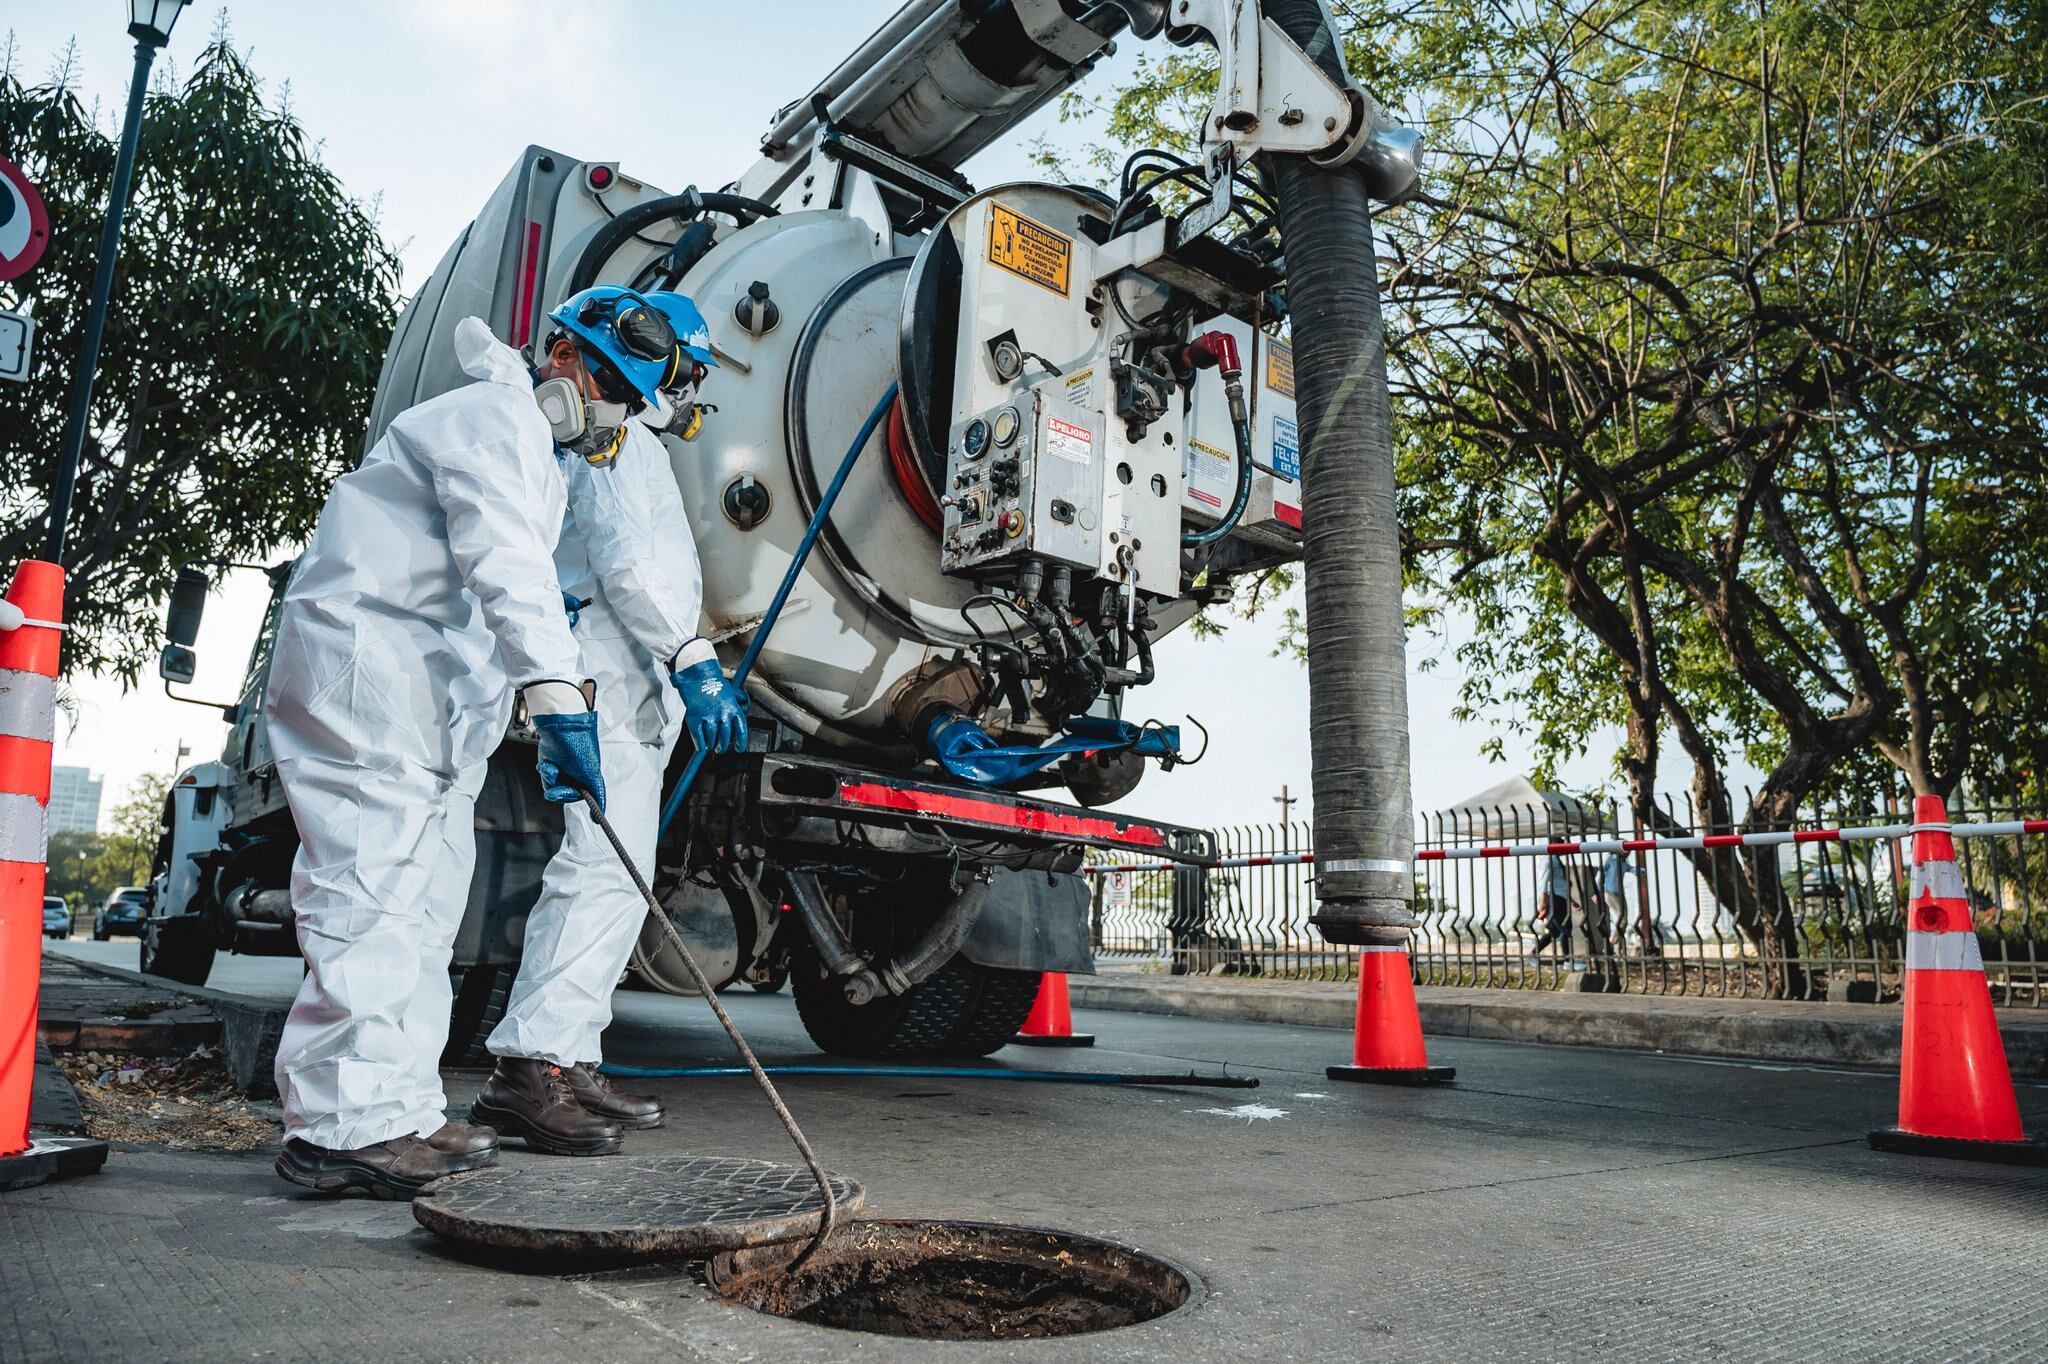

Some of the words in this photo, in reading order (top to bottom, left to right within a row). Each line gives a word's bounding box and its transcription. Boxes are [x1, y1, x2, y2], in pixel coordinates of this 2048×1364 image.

[1019, 244, 1032, 253] ESTE
[1022, 238, 1030, 246] NO
[1032, 242, 1060, 260] ADELANTE
[1024, 254, 1047, 268] CUANDO
[1049, 265, 1056, 273] VA
[1031, 271, 1061, 289] IZQUIERDA
[1056, 422, 1090, 440] PELIGRO
[1275, 445, 1289, 462] TEL:
